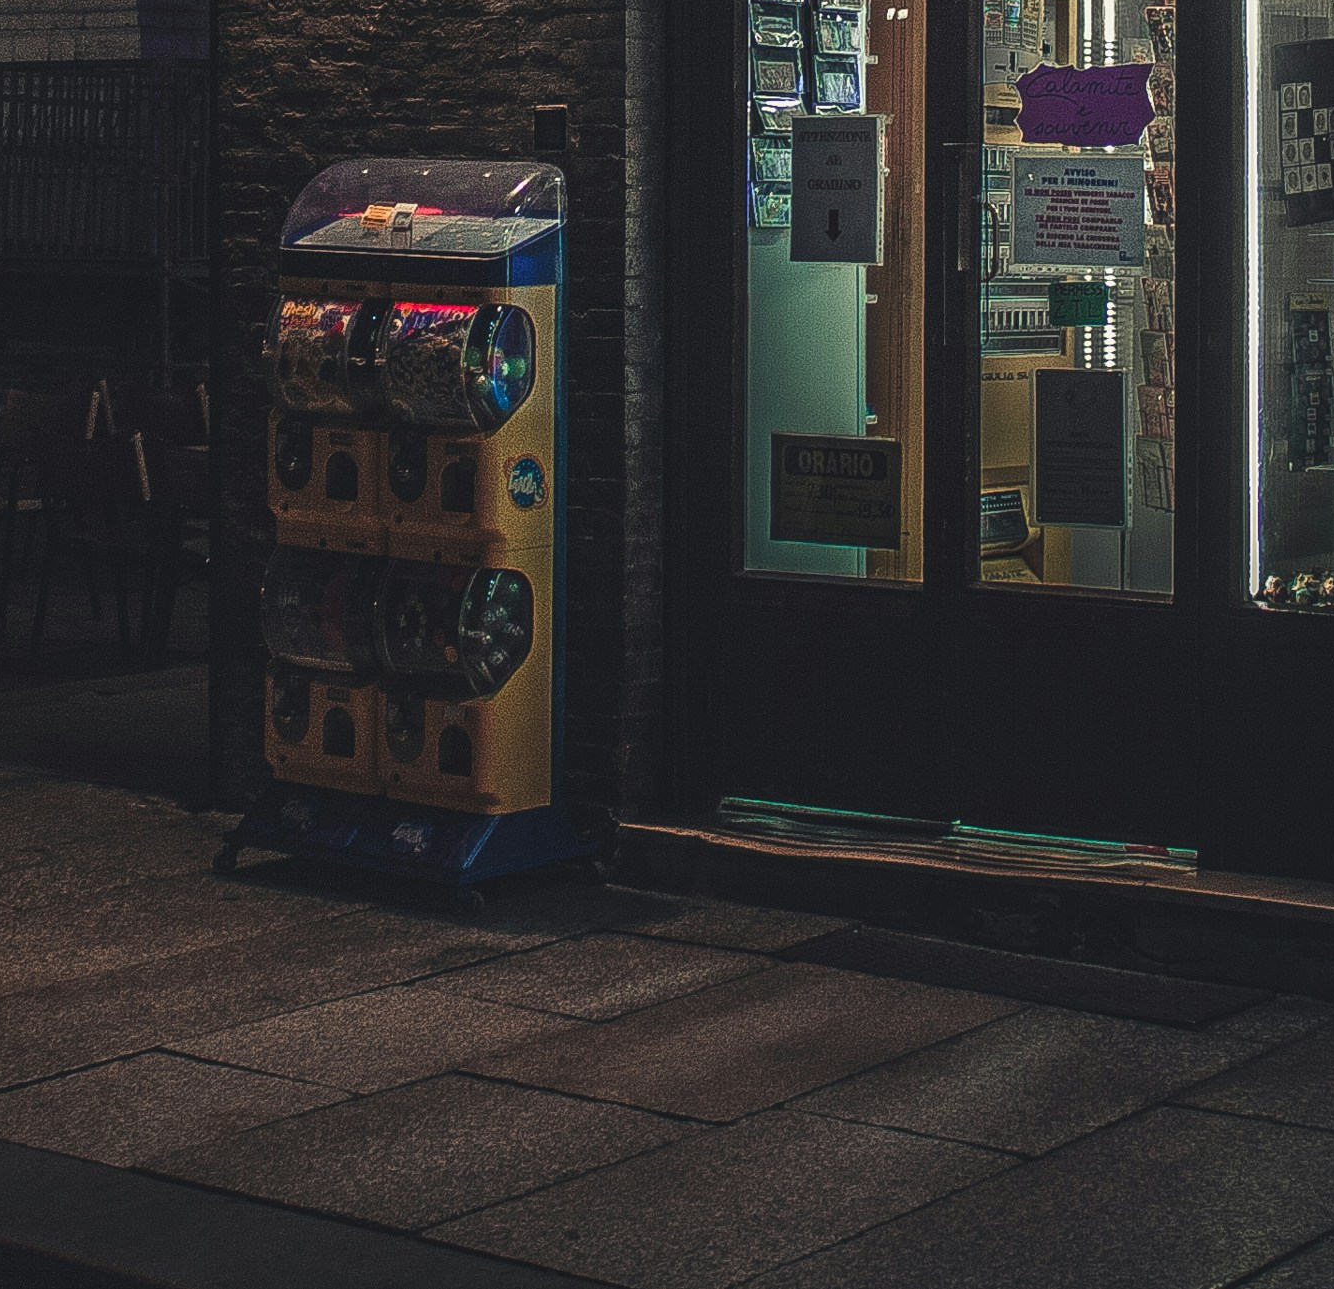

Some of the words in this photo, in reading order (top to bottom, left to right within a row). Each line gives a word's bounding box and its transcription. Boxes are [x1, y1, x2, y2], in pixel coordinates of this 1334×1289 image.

[1025, 68, 1140, 105] Calamite
[1031, 120, 1139, 136] souvenir
[797, 130, 872, 143] ATTENZIONE
[825, 154, 843, 166] AL
[1064, 168, 1096, 177] AVVISO
[807, 179, 862, 191] GRADINO
[1041, 177, 1058, 185] PER
[1067, 178, 1119, 188] MINORENNI
[798, 449, 874, 478] ORARIO
